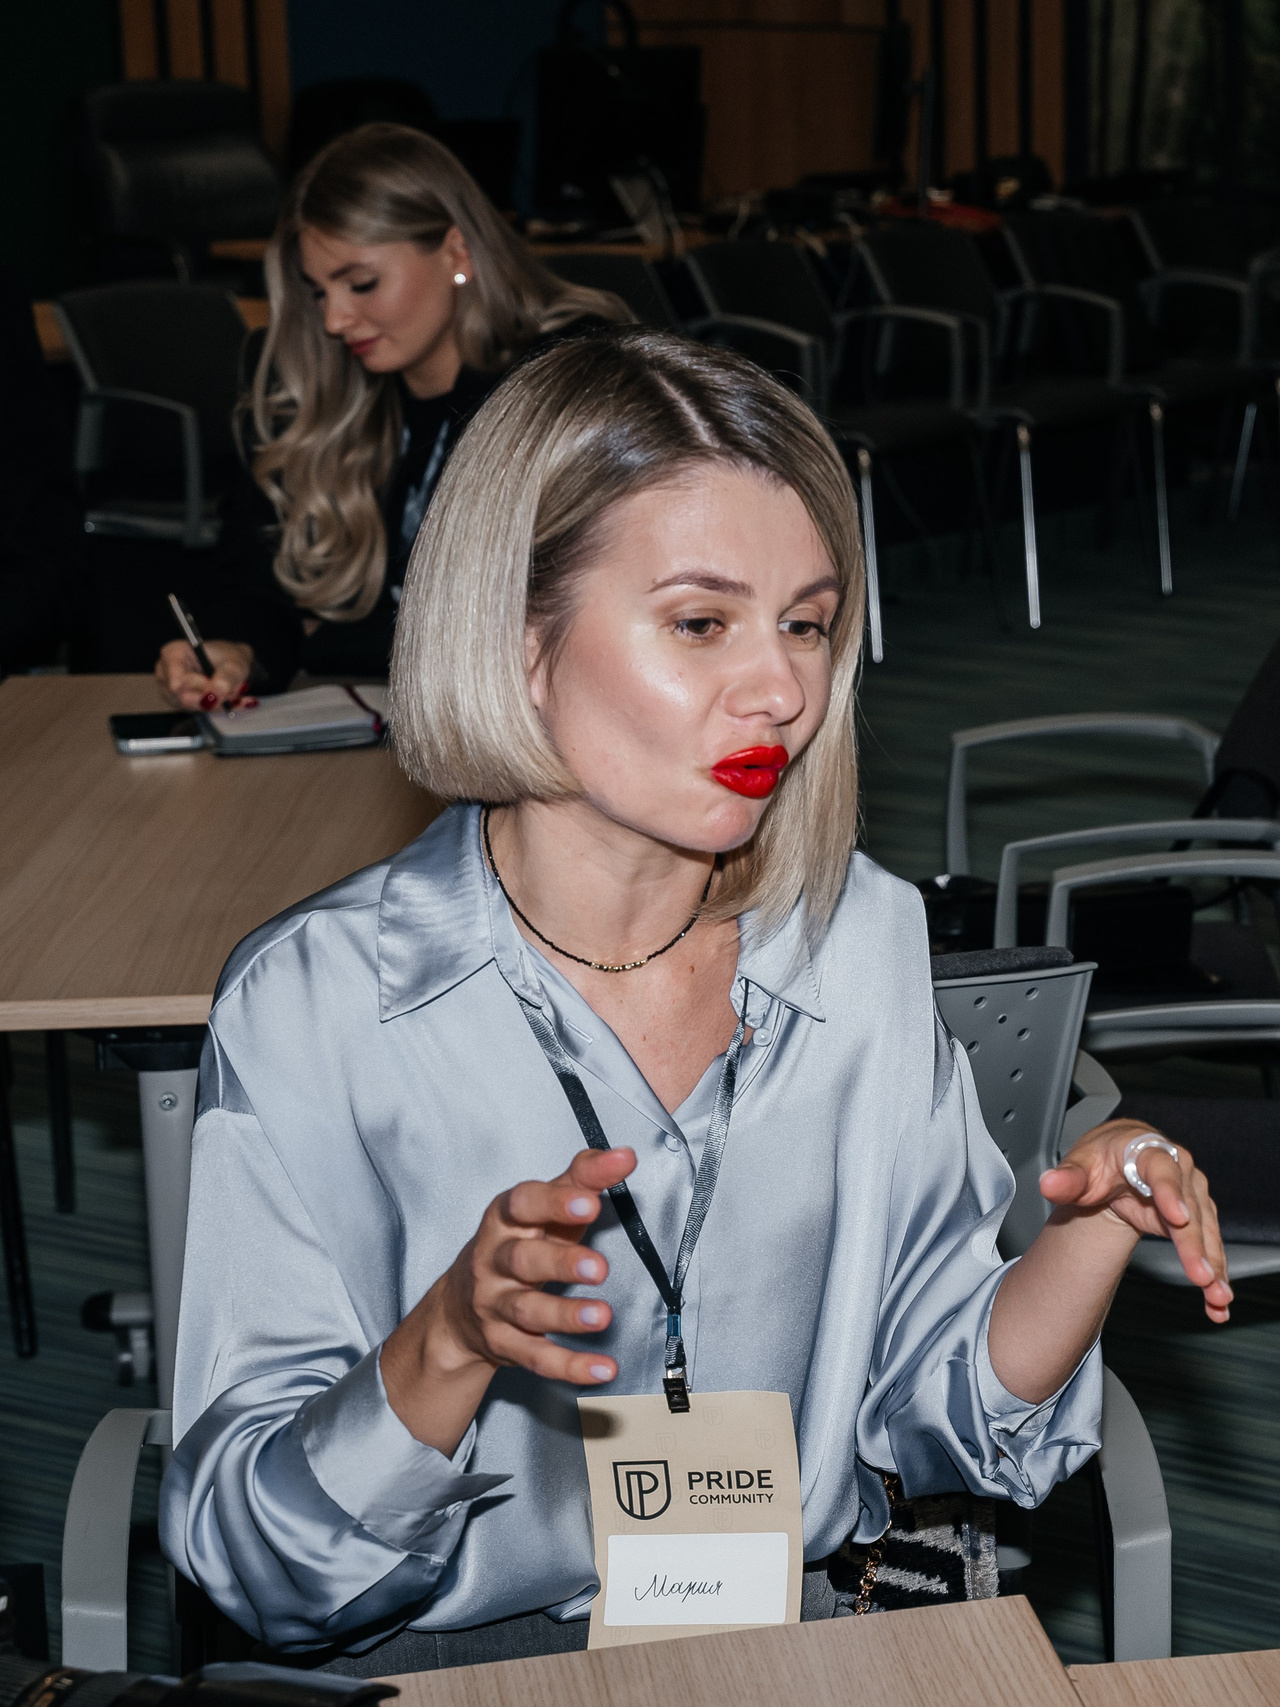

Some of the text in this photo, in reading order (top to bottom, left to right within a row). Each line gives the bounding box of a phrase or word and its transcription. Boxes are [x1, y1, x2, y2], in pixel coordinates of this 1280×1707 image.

[687, 1470, 774, 1490] PRIDE
[689, 1493, 774, 1505] COMMUNITY
[635, 1574, 723, 1603] Мария
